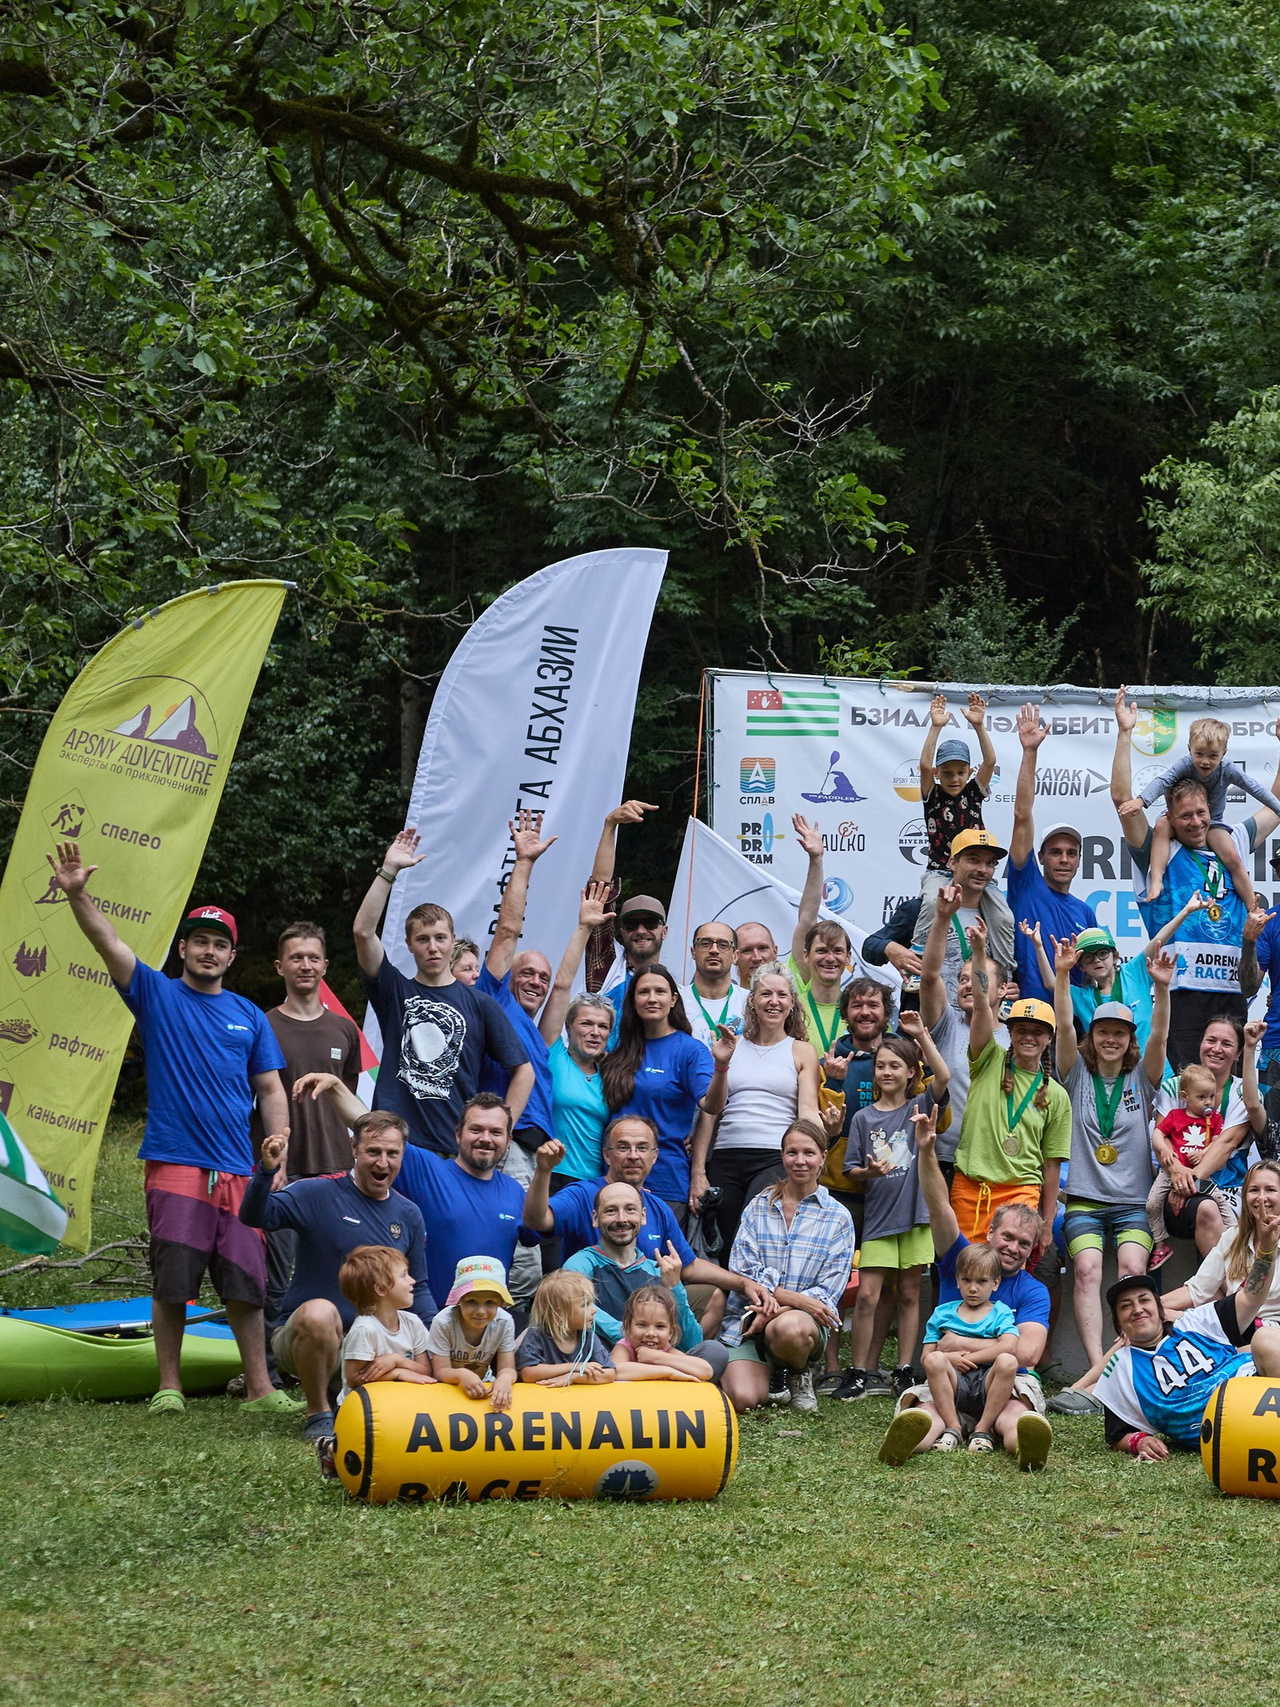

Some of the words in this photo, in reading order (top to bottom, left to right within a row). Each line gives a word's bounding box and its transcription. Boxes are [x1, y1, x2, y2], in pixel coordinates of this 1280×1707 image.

[525, 625, 579, 765] АБХАЗИИ
[63, 728, 120, 759] APSNY
[119, 744, 217, 786] ADVENTURE
[59, 750, 107, 771] эксперты
[109, 763, 123, 774] по
[125, 767, 208, 797] приключениям
[1035, 767, 1083, 781] KAYAK
[740, 796, 776, 806] СПЛАВ
[100, 822, 162, 851] спелео
[1195, 953, 1238, 967] ADRENA
[1195, 966, 1227, 980] RACE
[1228, 970, 1240, 982] 20
[68, 962, 114, 989] кемп
[1125, 1104, 1141, 1113] TEAM
[1152, 1338, 1216, 1398] 44
[405, 1409, 706, 1453] ADRENALIN
